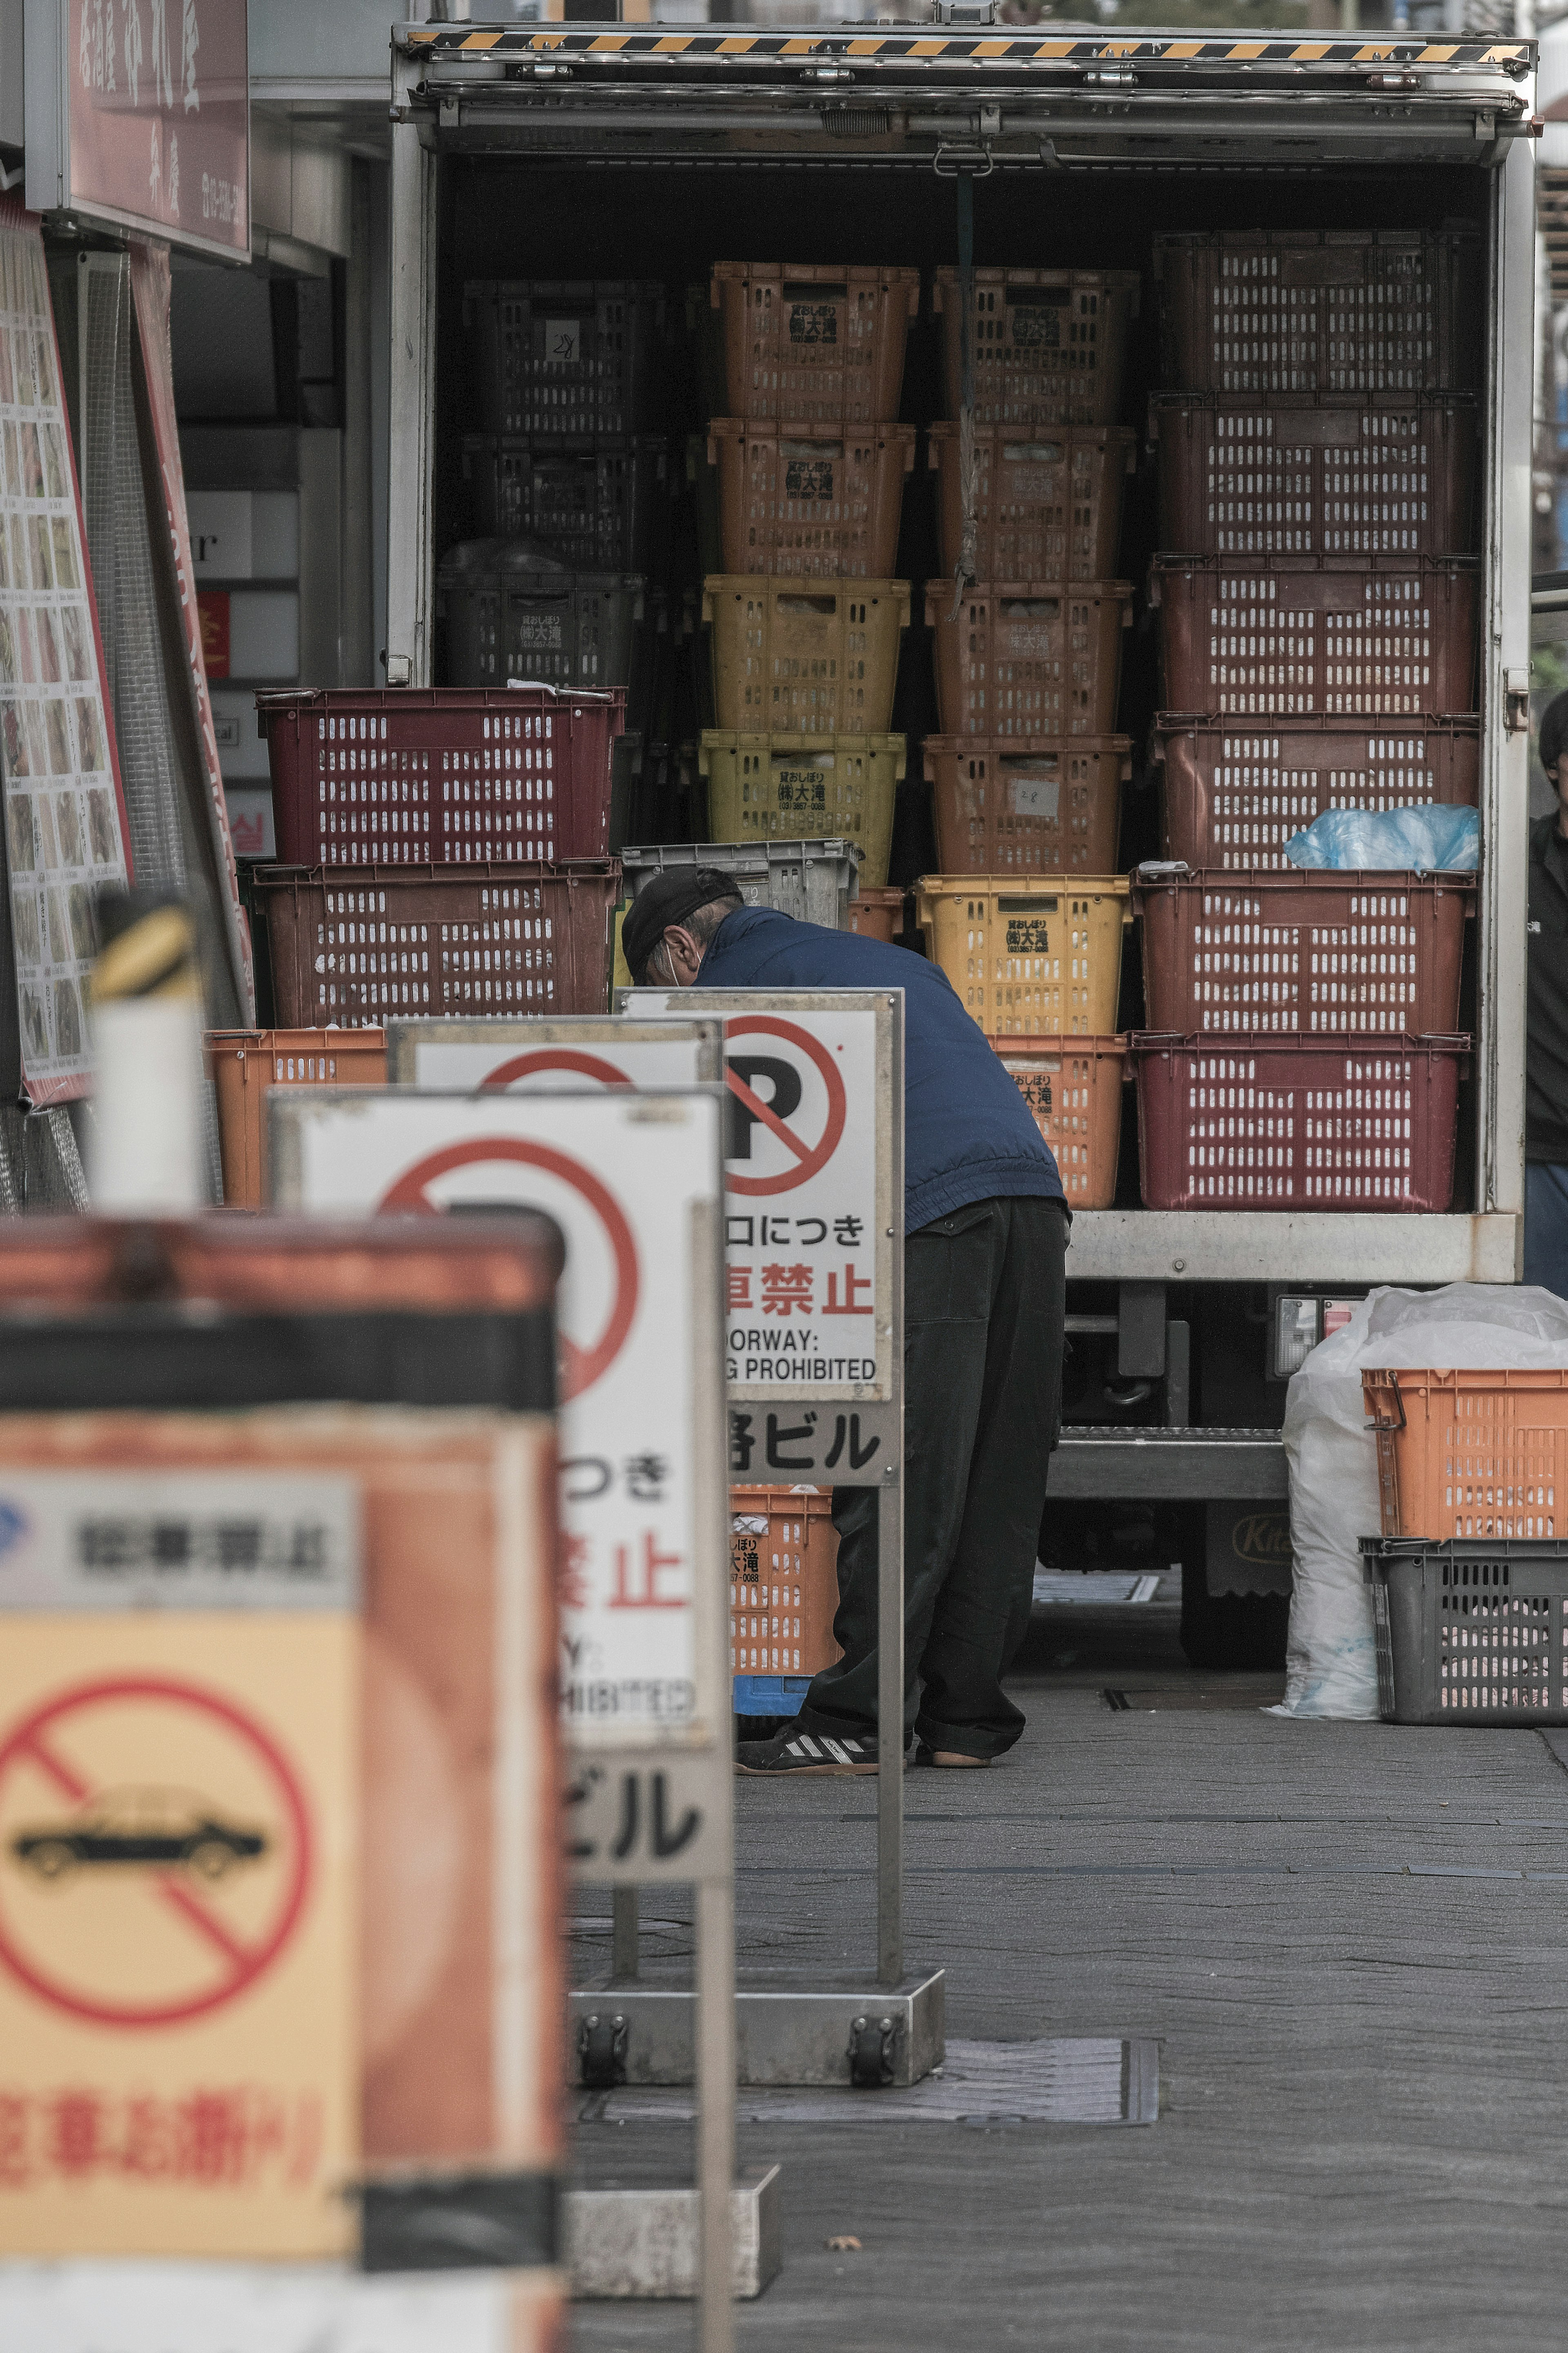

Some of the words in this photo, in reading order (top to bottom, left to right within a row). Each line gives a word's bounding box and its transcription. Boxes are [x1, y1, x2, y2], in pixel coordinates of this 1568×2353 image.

[1011, 1074, 1051, 1086] おしぼり
[726, 1328, 819, 1351] ORWAY:
[746, 1357, 876, 1380] PROHIBITED
